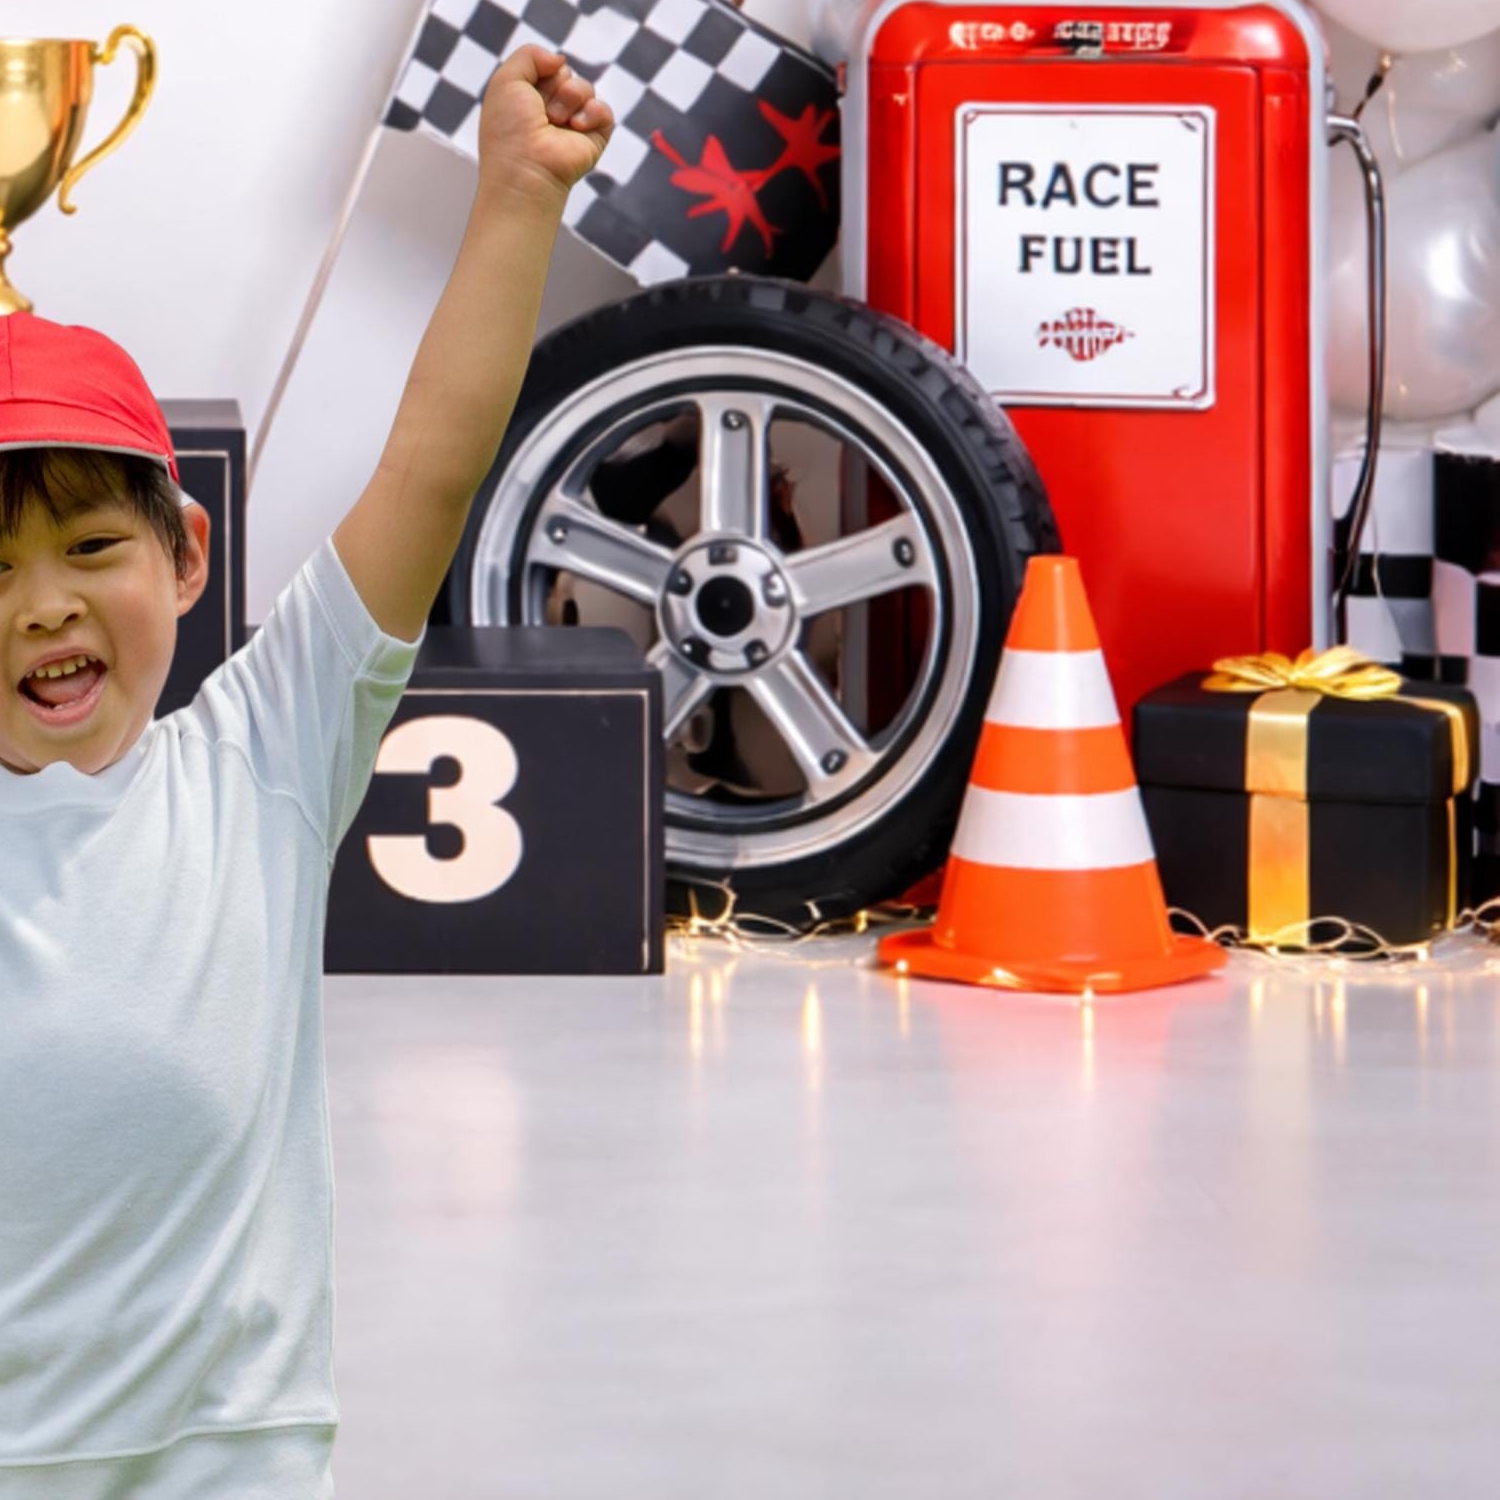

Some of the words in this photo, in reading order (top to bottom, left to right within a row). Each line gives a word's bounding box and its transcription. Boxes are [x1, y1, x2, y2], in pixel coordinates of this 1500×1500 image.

[997, 161, 1161, 210] RACE
[1018, 234, 1153, 276] FUEL
[366, 716, 524, 904] 3
